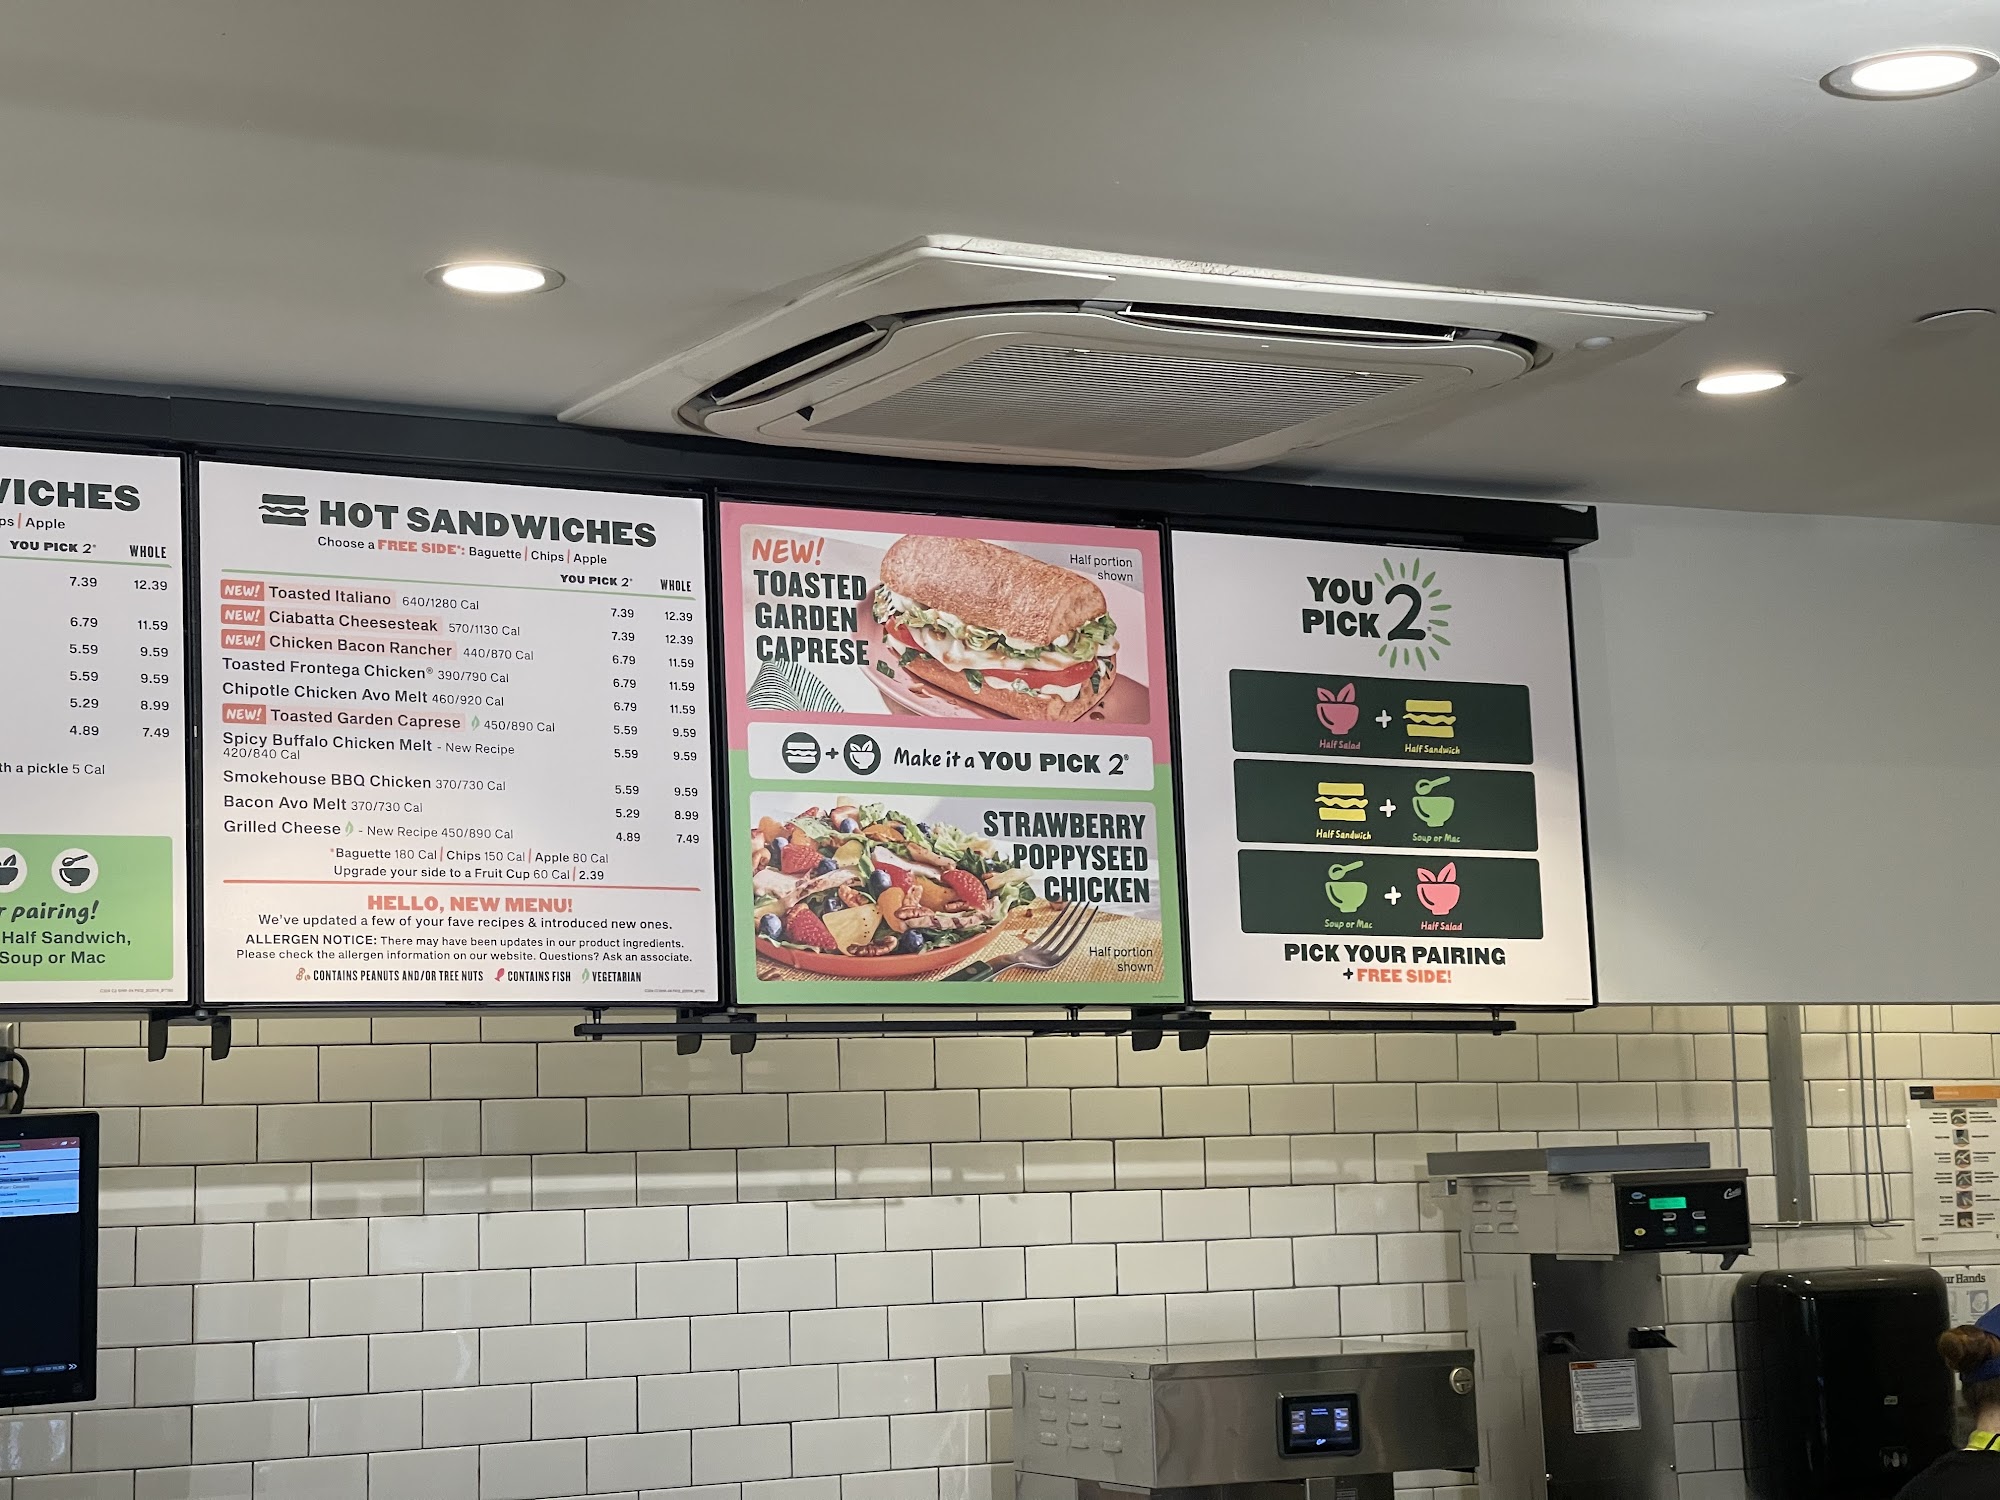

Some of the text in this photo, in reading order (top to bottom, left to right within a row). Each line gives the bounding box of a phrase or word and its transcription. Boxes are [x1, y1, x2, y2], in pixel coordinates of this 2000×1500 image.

[25, 517, 65, 530] Apple
[320, 500, 656, 547] HOT SANDWICHES
[10, 540, 78, 552] YOU PICK
[130, 545, 166, 558] WHOLE
[318, 537, 364, 549] Choose
[368, 542, 374, 550] a
[378, 540, 417, 552] FREE
[469, 546, 522, 560] Baguette
[531, 551, 564, 562] Chips
[574, 554, 607, 565] Apple
[752, 537, 824, 566] NEW!
[1070, 554, 1132, 568] Half portion
[560, 574, 618, 586] YOU PICK
[1098, 570, 1134, 582] shown
[70, 577, 168, 590] 7.39 12.39
[660, 579, 691, 592] WHOLE
[754, 570, 866, 600] TOASTED
[1307, 576, 1373, 605] YOU
[224, 585, 479, 610] NEW! Toasted Italiano 640/1280 Cal
[70, 617, 168, 630] 6.79 11.59
[224, 610, 438, 632] NEW! Ciabatta Cheesesteak
[756, 602, 858, 632] GARDEN
[1302, 608, 1381, 638] PICK
[70, 644, 168, 657] 5.59 9.59
[225, 635, 452, 656] NEW! Chicken Bacon Rancher
[756, 634, 870, 665] CAPRESE
[222, 658, 285, 672] Toasted
[290, 661, 360, 677] Frontega
[70, 671, 168, 684] 5.59 9.59
[222, 682, 428, 703] Chipotle Chicken Avo Melt
[70, 698, 169, 710] 5.29 8.99
[226, 708, 460, 729] NEW! Toasted Garden Caprese
[70, 726, 169, 738] 4.89 7.49
[223, 732, 432, 752] Spicy Buffalo Chicken Melt
[1320, 739, 1360, 750] Half Salad
[1405, 744, 1460, 754] Half Sandwich
[894, 747, 942, 767] Make
[946, 750, 960, 766] it
[965, 756, 974, 768] a
[978, 751, 1031, 771] YOU
[1040, 753, 1100, 773] PICK
[16, 763, 105, 775] a pickle 5 Cal
[224, 770, 431, 788] Smokehouse BBQ Chicken
[224, 796, 346, 810] Bacon Avo Melt
[224, 820, 340, 834] Grilled Cheese
[984, 810, 1146, 839] STRAWBERRY
[1316, 829, 1371, 840] Half Sandwich
[1412, 833, 1432, 842] Soup
[1445, 834, 1460, 842] Mac
[1014, 844, 1148, 871] POPPYSEED
[1044, 876, 1150, 902] CHICKEN
[368, 896, 572, 913] HELLO, NEW MENU!
[11, 900, 99, 924] pairing!
[259, 915, 672, 930] We've updated a few of your fave recipes & introduced new ones.
[1325, 920, 1344, 929] Soup
[1357, 920, 1373, 929] Mac
[1421, 922, 1462, 930] Half Salad
[2, 931, 131, 946] Half Sandwich,
[246, 934, 318, 945] ALLERGEN
[324, 935, 377, 945] NOTICE:
[380, 936, 412, 946] There
[417, 938, 438, 947] may
[442, 938, 467, 946] have
[471, 938, 496, 946] been
[501, 938, 542, 948] updates
[546, 938, 555, 946] in
[579, 939, 619, 949] product
[623, 939, 684, 949] ingredients.
[0, 952, 106, 966] Soup or Mac
[1089, 946, 1153, 958] Half portion
[1284, 943, 1506, 965] PICK YOUR PAIRING
[1117, 962, 1153, 972] shown
[314, 970, 642, 982] CONTAINS PEANUTS AND/OR TREE NUTS CONTAINS FISH VEGETARIAN
[1357, 968, 1452, 983] FREE SIDE!
[1956, 1273, 1986, 1284] Hands
